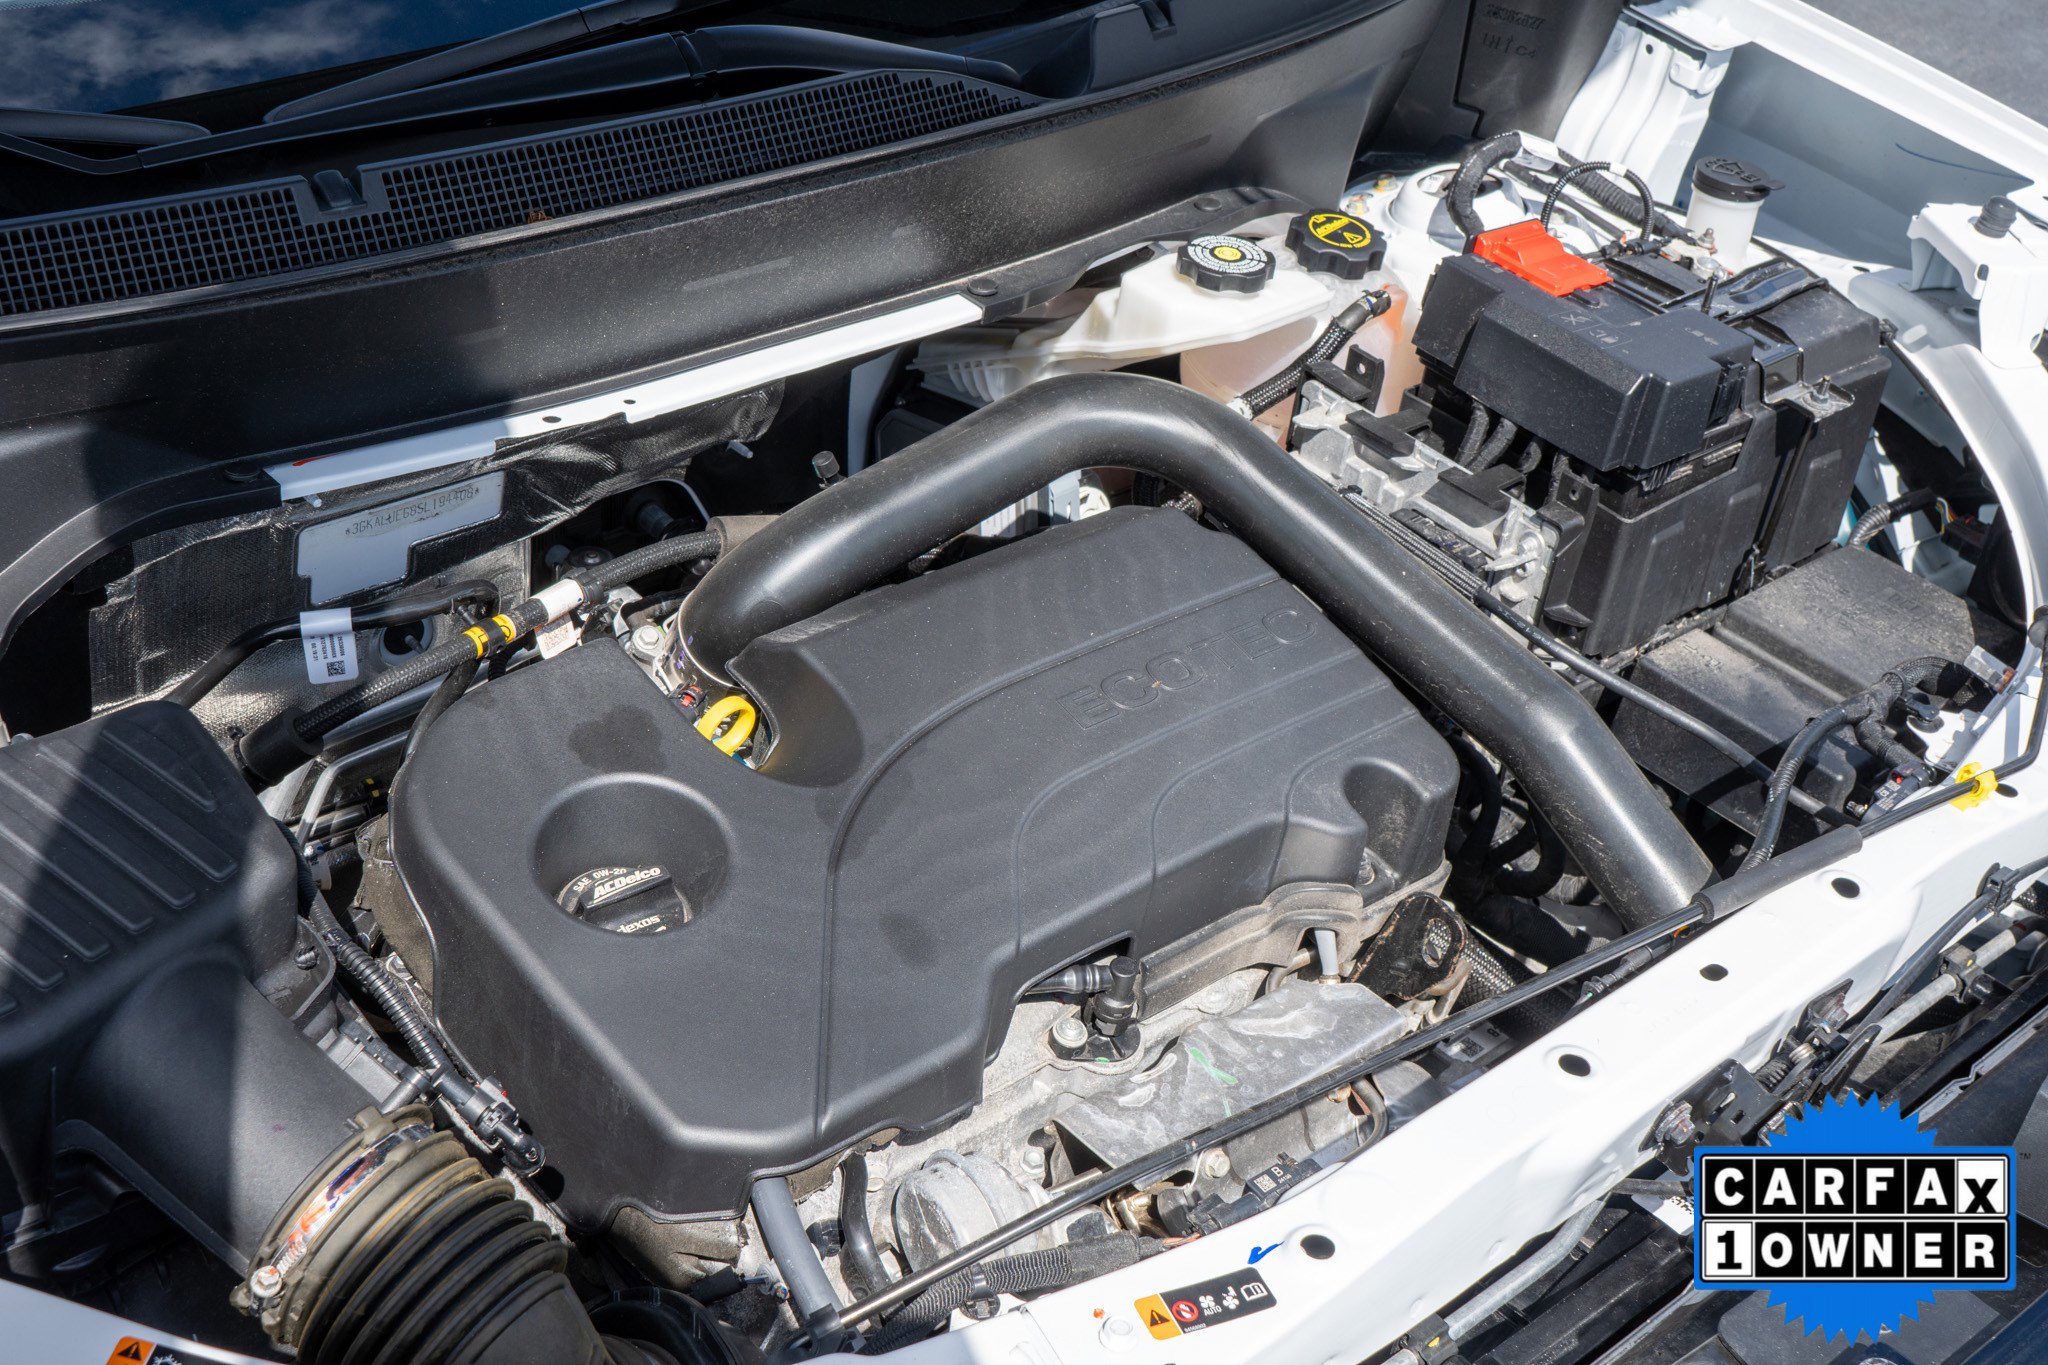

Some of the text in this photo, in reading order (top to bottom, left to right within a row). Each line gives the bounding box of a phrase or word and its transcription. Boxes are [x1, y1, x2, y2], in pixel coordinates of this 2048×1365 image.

[1057, 606, 1316, 730] ECOTEC
[573, 876, 592, 892] SAE
[594, 867, 661, 900] ACDelco
[1271, 1166, 1284, 1177] B
[1203, 1305, 1222, 1316] AUTO
